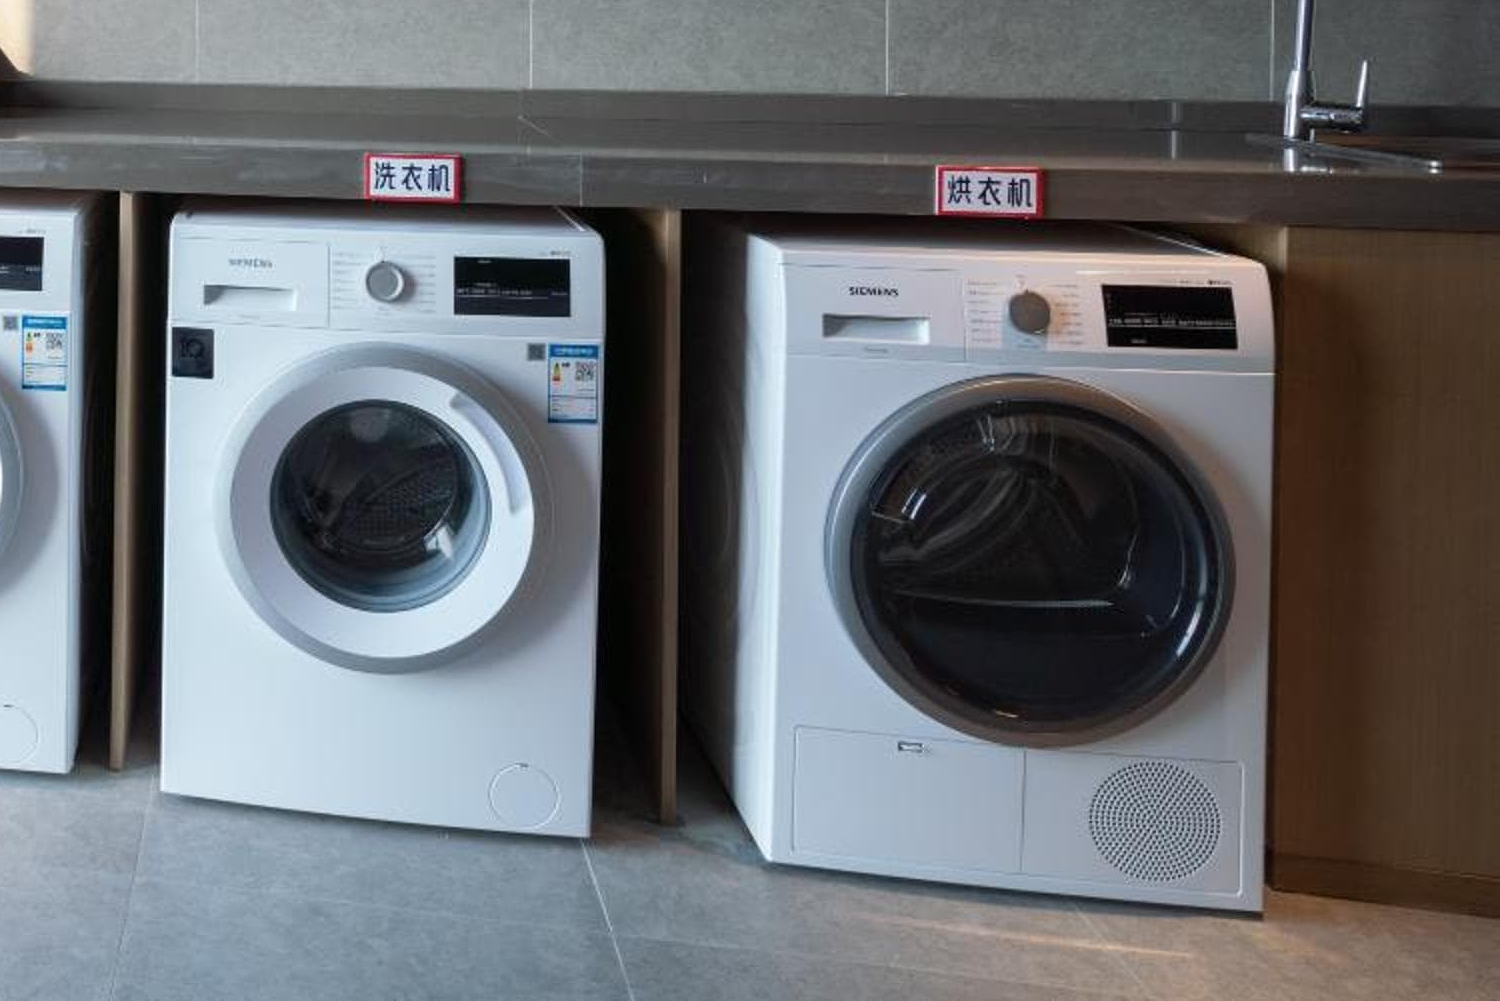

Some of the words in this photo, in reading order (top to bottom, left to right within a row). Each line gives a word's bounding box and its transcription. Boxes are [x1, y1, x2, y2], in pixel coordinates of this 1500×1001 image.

[375, 161, 451, 192] 洗衣机
[947, 174, 1032, 208] 烘衣机
[848, 286, 900, 296] SIEMENS
